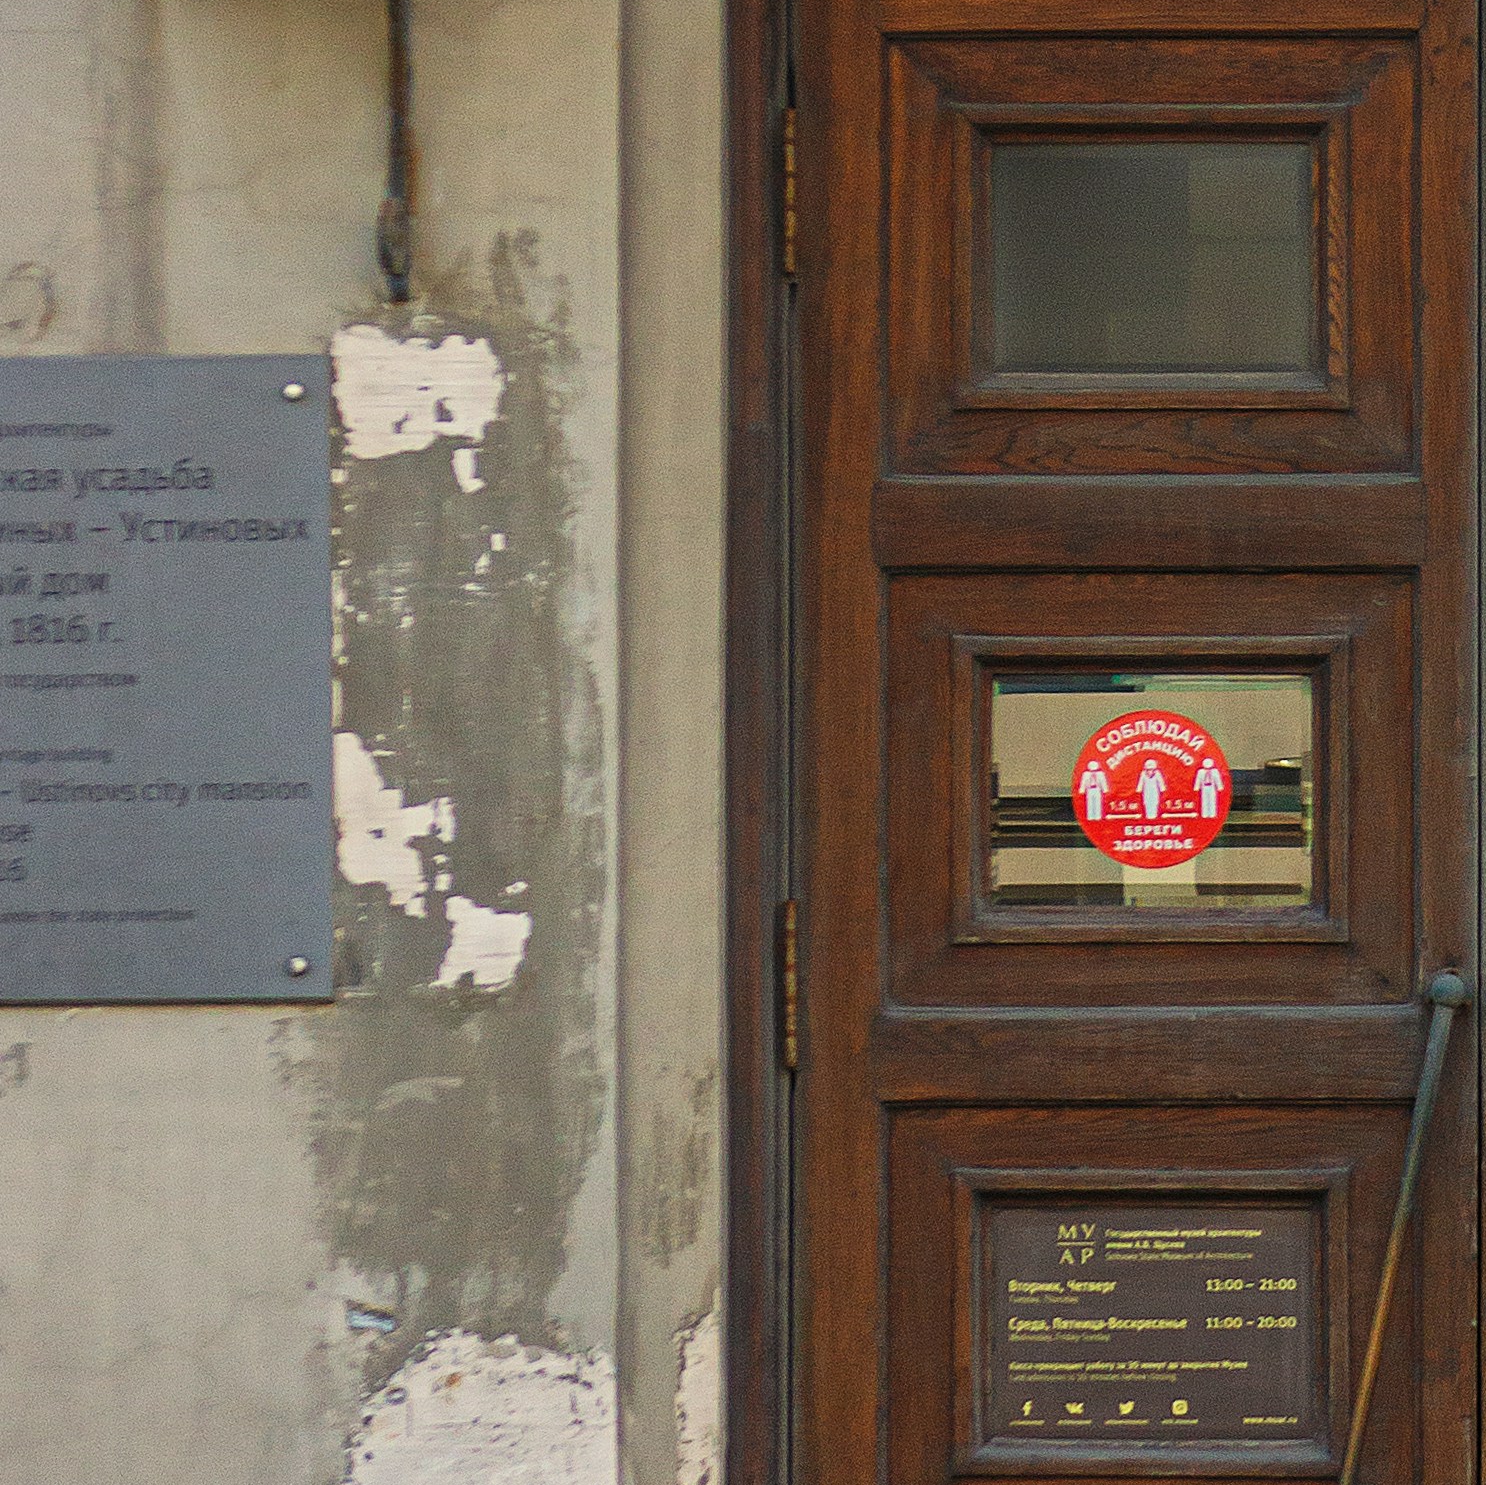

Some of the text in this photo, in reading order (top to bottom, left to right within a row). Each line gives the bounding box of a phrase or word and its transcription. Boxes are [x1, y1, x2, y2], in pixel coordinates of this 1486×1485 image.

[72, 456, 214, 500] усадьба
[119, 512, 310, 543] Устиновых
[38, 571, 111, 600] дом
[9, 614, 89, 644] 1816
[1095, 719, 1206, 752] СОБЛЮДАЙ
[1105, 740, 1195, 770] ДИСТАНЦИЮ
[1112, 838, 1194, 852] ЗДОРОВЬЕ
[1124, 824, 1183, 836] БЕРЕГИ
